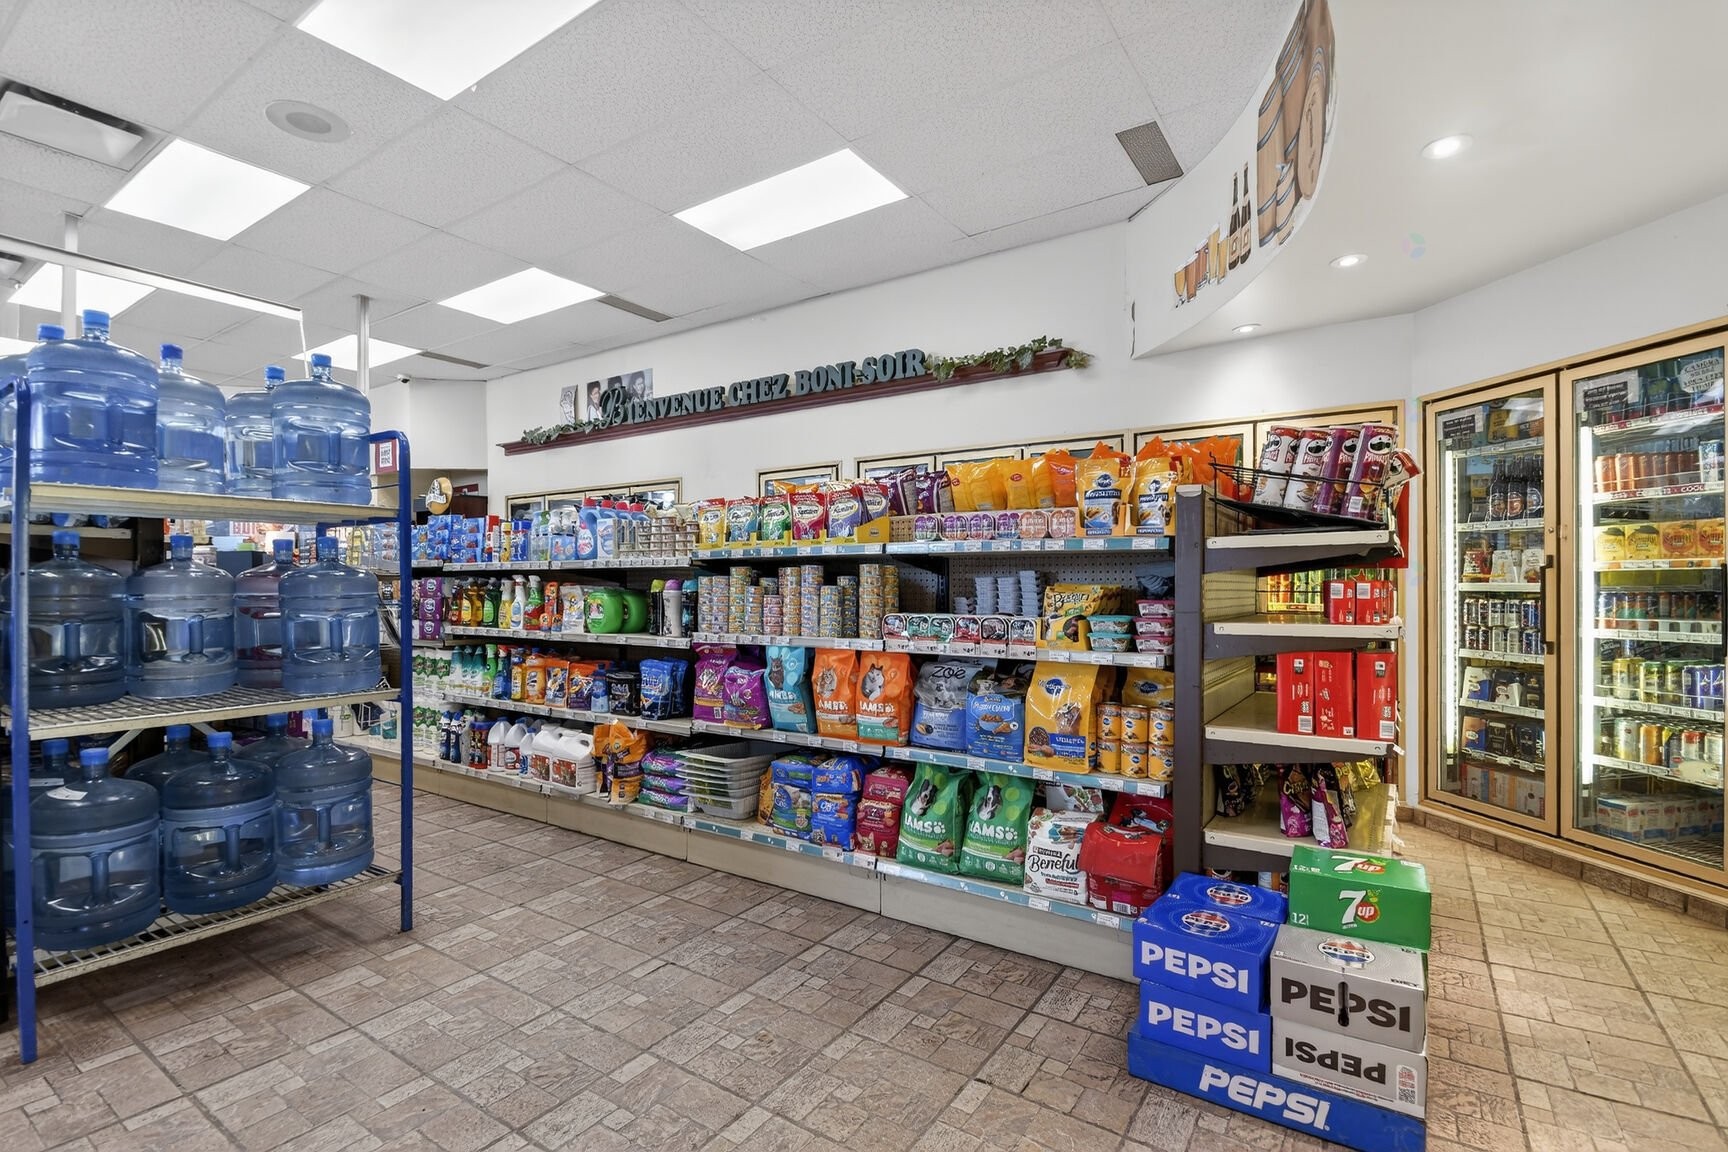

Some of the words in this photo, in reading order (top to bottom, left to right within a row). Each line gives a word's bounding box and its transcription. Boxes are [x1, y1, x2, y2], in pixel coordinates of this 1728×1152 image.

[600, 386, 724, 428] BIENVENUE
[727, 373, 790, 407] CHEZ
[904, 812, 933, 834] IAMS
[970, 820, 1006, 841] IAMS
[1141, 940, 1249, 994] PEPSI
[1149, 1000, 1260, 1055] PEPSI
[1281, 977, 1411, 1032] PEPSI
[1285, 1037, 1386, 1085] PEPSI
[1199, 1063, 1330, 1131] PEPSI
